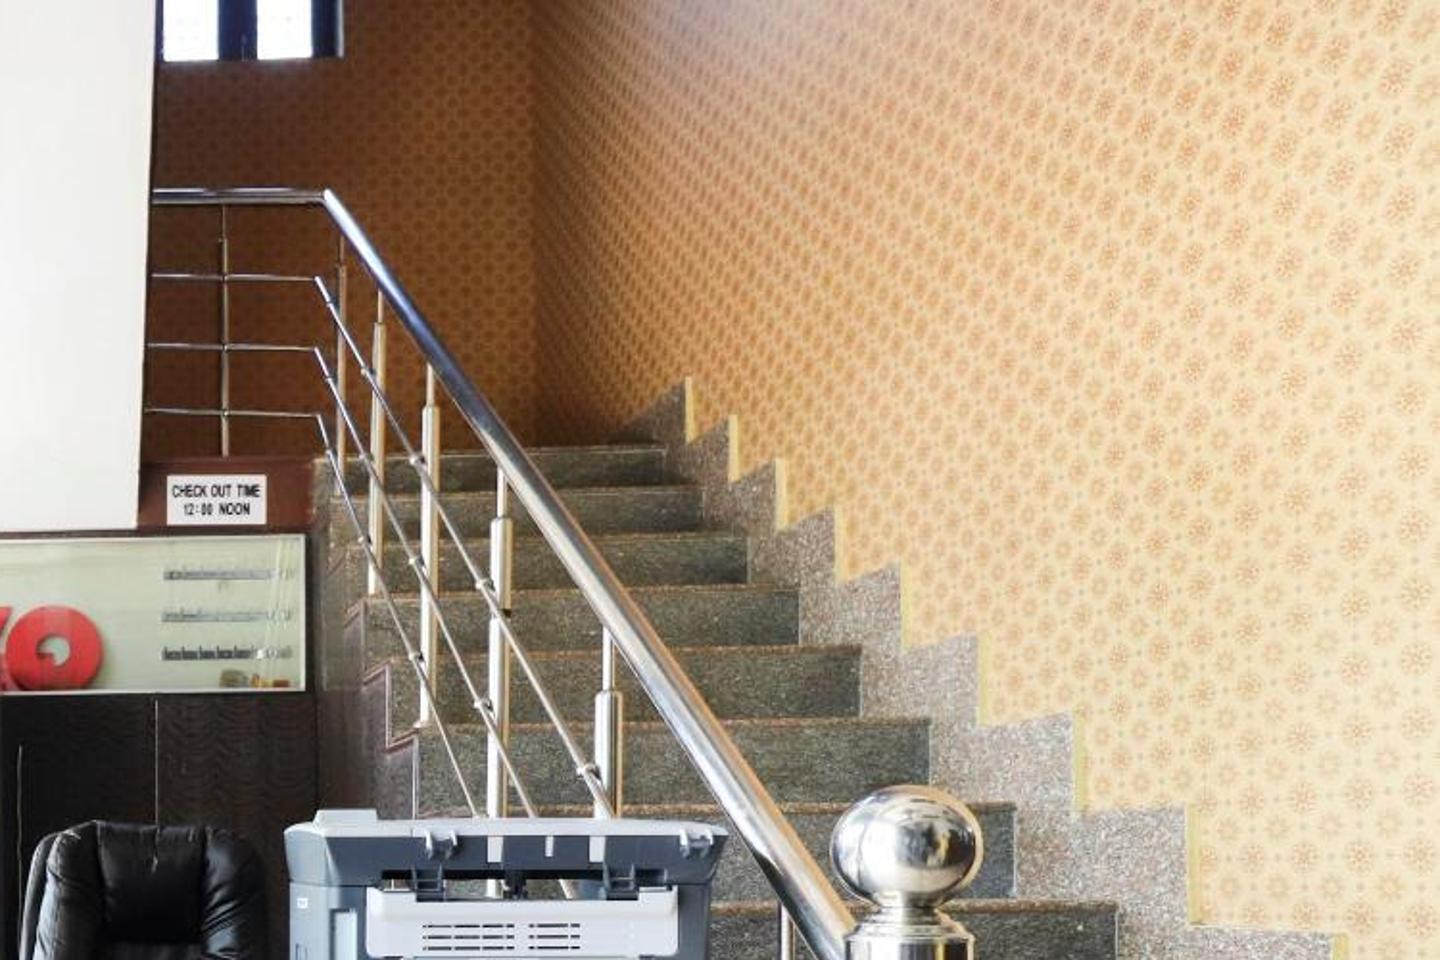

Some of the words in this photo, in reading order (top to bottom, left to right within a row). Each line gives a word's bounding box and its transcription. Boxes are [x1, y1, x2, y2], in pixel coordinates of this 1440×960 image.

[172, 484, 208, 498] CHECK
[210, 484, 232, 498] OUT
[237, 484, 261, 498] TIME
[184, 502, 213, 516] 12:00
[219, 502, 251, 516] NOON
